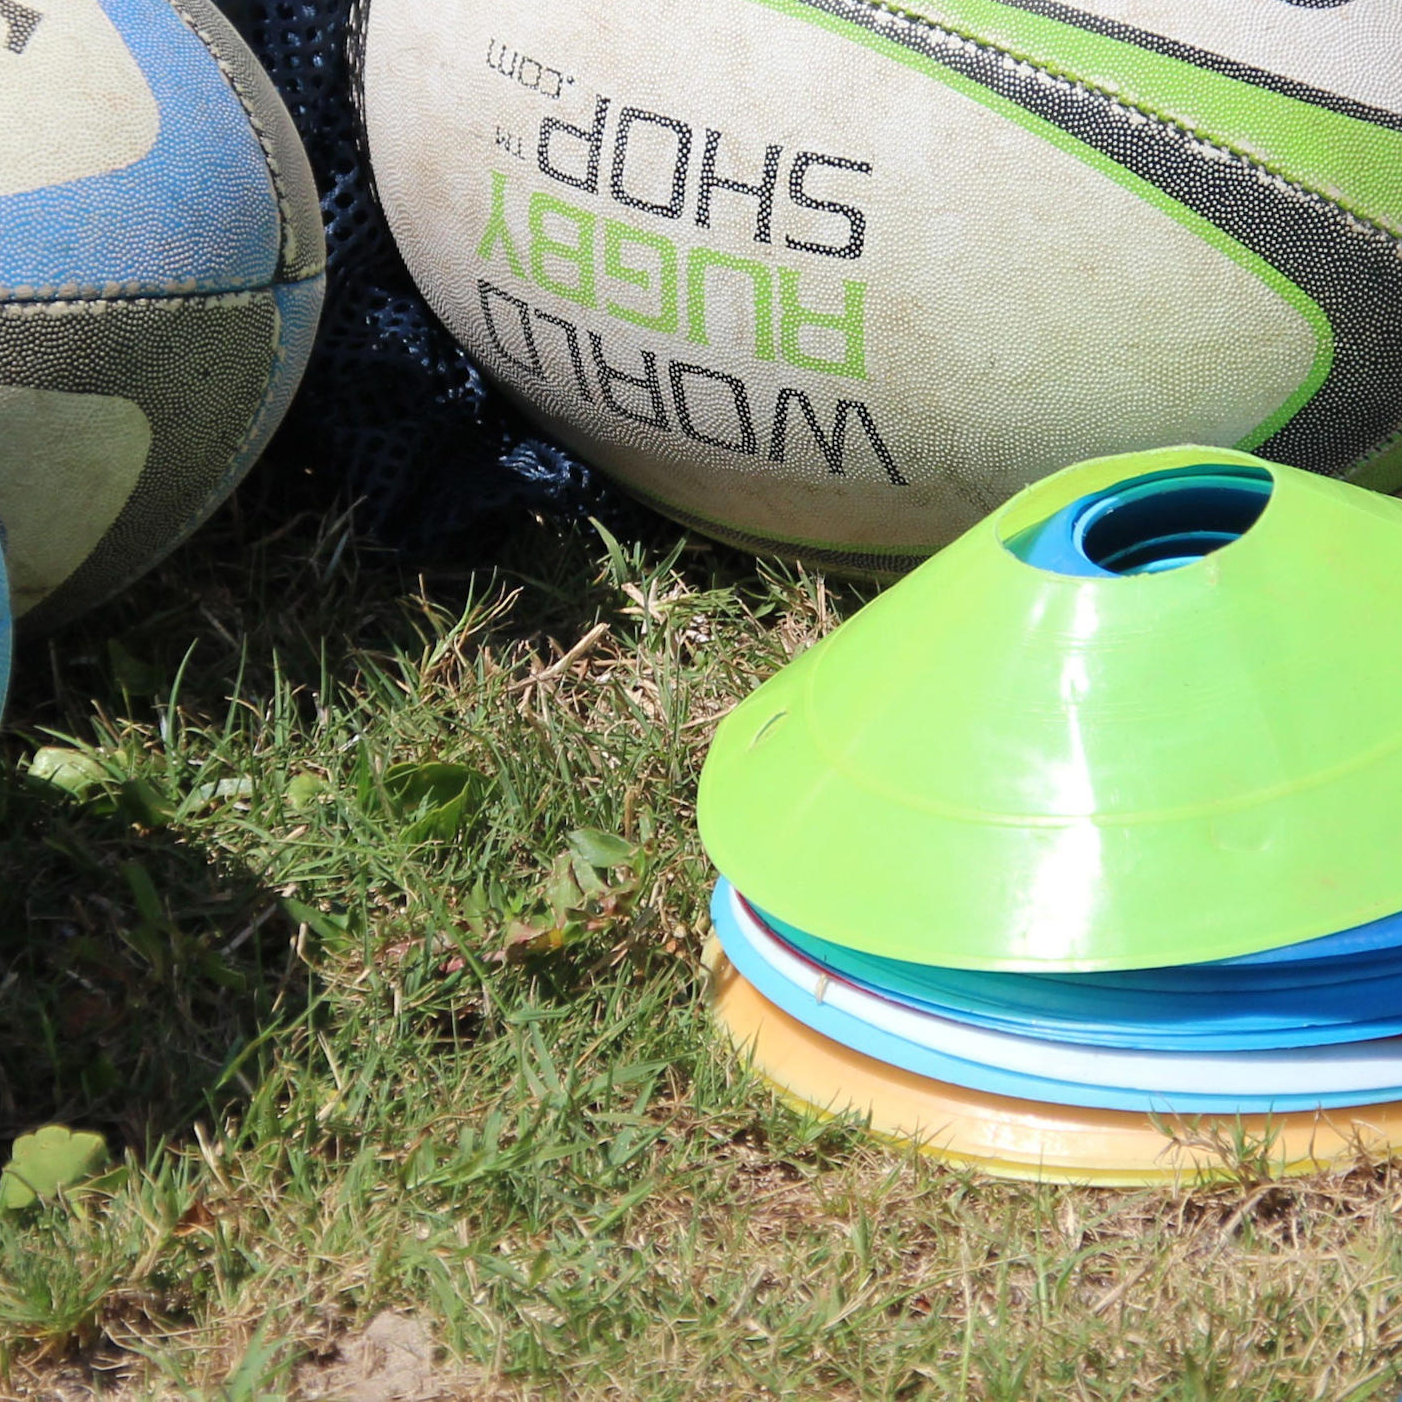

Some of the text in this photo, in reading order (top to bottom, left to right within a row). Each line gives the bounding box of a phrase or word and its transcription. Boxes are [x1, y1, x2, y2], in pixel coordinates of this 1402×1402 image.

[476, 168, 867, 381] RUGBY
[537, 94, 873, 260] SHOP
[478, 278, 909, 486] WORLD
